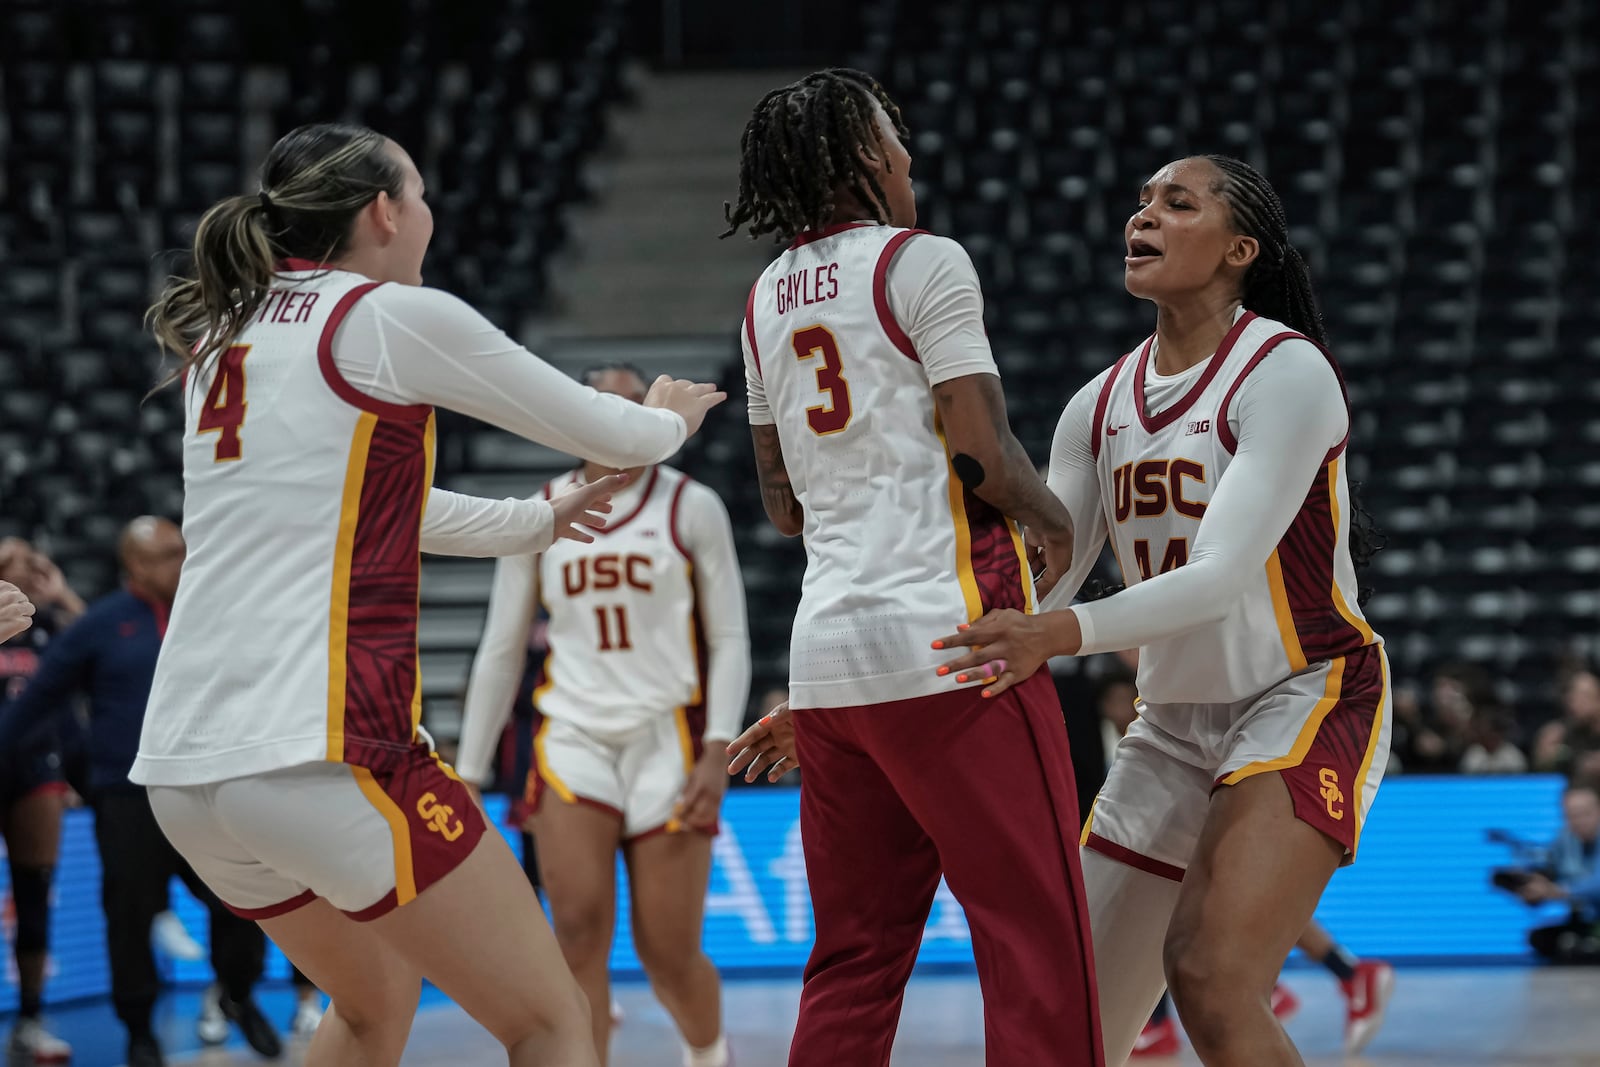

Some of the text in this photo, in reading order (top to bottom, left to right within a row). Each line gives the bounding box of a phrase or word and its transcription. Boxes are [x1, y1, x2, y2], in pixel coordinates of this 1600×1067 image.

[250, 289, 320, 323] TIER
[777, 262, 839, 315] GAYLES
[198, 344, 252, 463] 4
[792, 324, 853, 436] 3
[1113, 457, 1208, 524] USC
[562, 553, 654, 598] USC
[594, 605, 634, 652] 11
